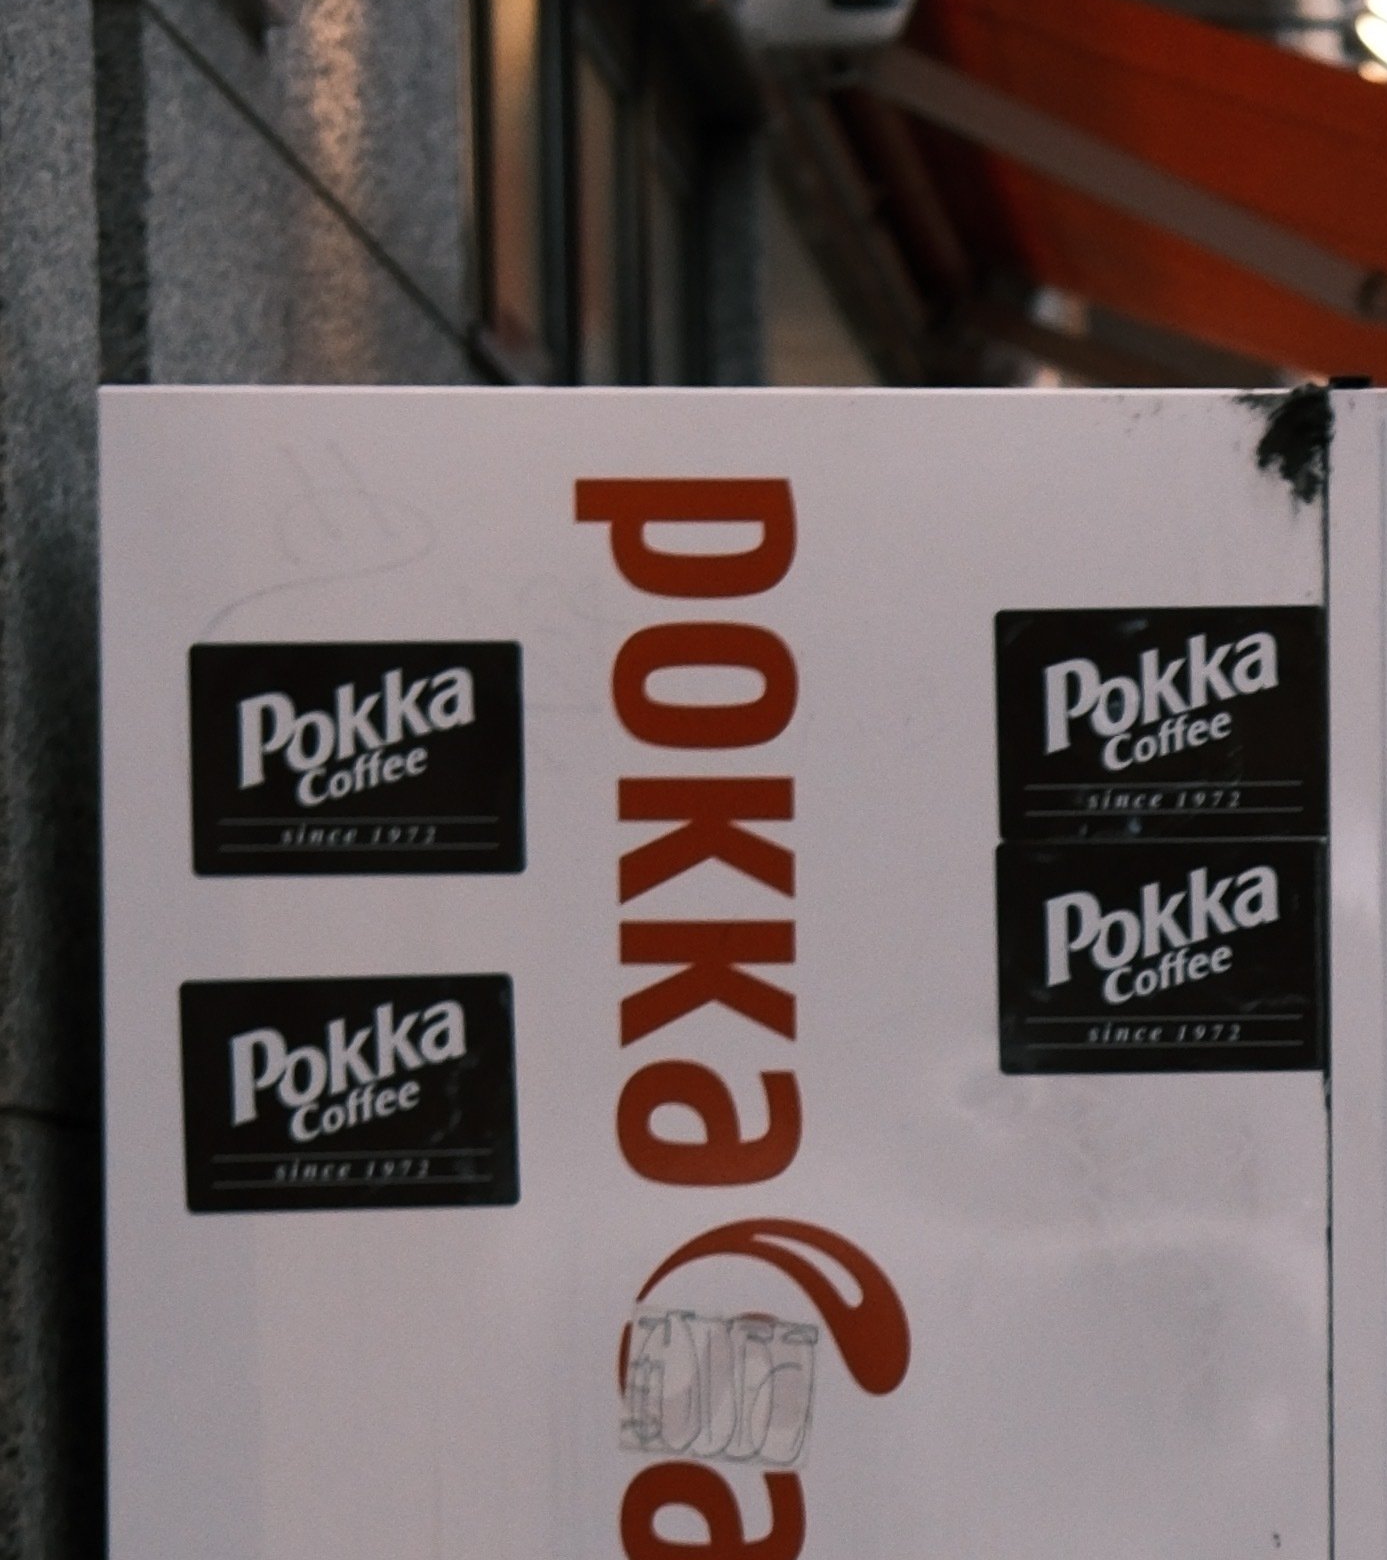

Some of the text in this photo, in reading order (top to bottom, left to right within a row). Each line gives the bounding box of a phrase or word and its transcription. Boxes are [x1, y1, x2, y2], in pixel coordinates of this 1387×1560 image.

[1043, 632, 1279, 756] Pokka
[238, 666, 476, 790] Pokka
[1102, 711, 1232, 772] Coffee
[295, 747, 429, 808] Coffee
[1086, 789, 1242, 810] since 1972
[280, 824, 438, 846] since 1972
[1044, 865, 1280, 988] Pokka
[1103, 945, 1234, 1006] Coffee
[229, 999, 468, 1128] Pokka
[1086, 1022, 1242, 1044] since 1972
[288, 1080, 421, 1142] Coffee
[274, 1159, 431, 1184] since 1972
